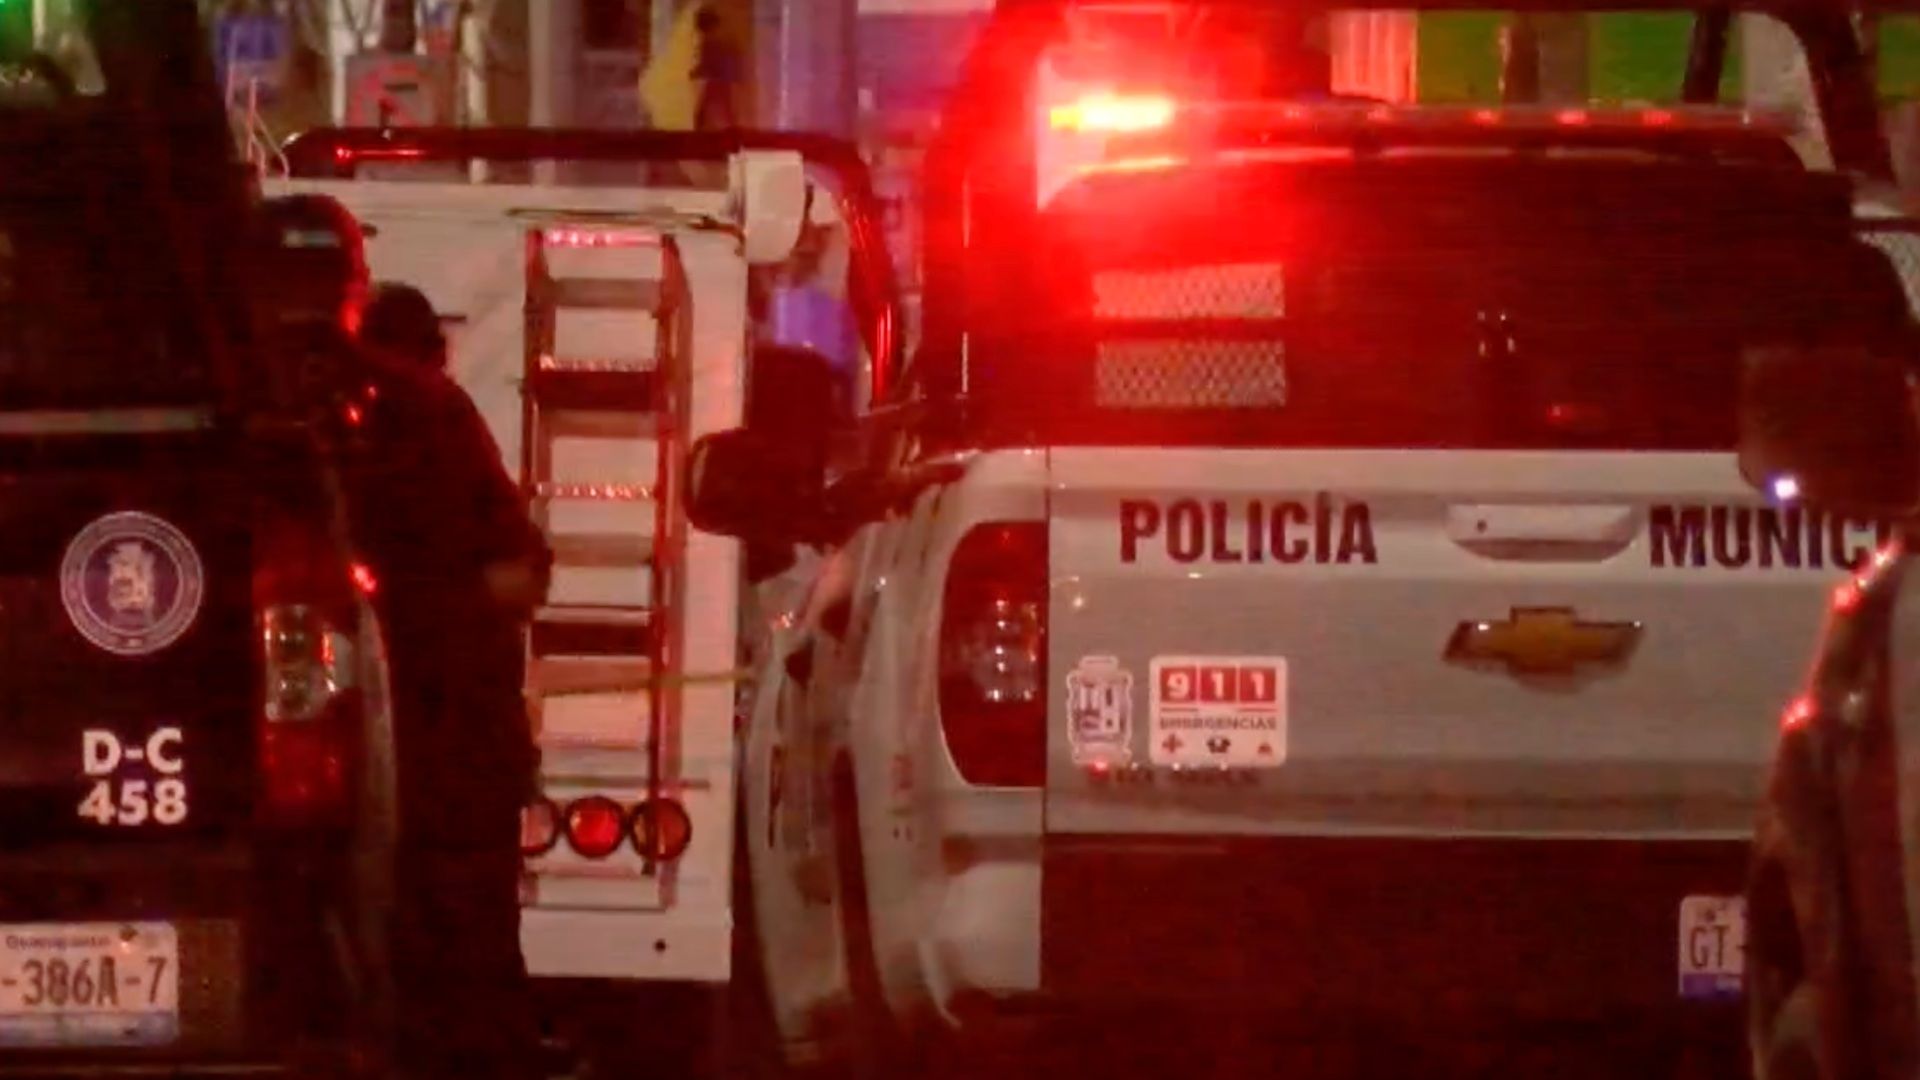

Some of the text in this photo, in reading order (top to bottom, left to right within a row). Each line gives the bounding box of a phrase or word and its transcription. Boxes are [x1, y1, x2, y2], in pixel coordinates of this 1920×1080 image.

[1119, 490, 1378, 564] POLICÍA
[1166, 670, 1266, 700] 911
[83, 727, 183, 774] D-C
[77, 779, 188, 825] 458
